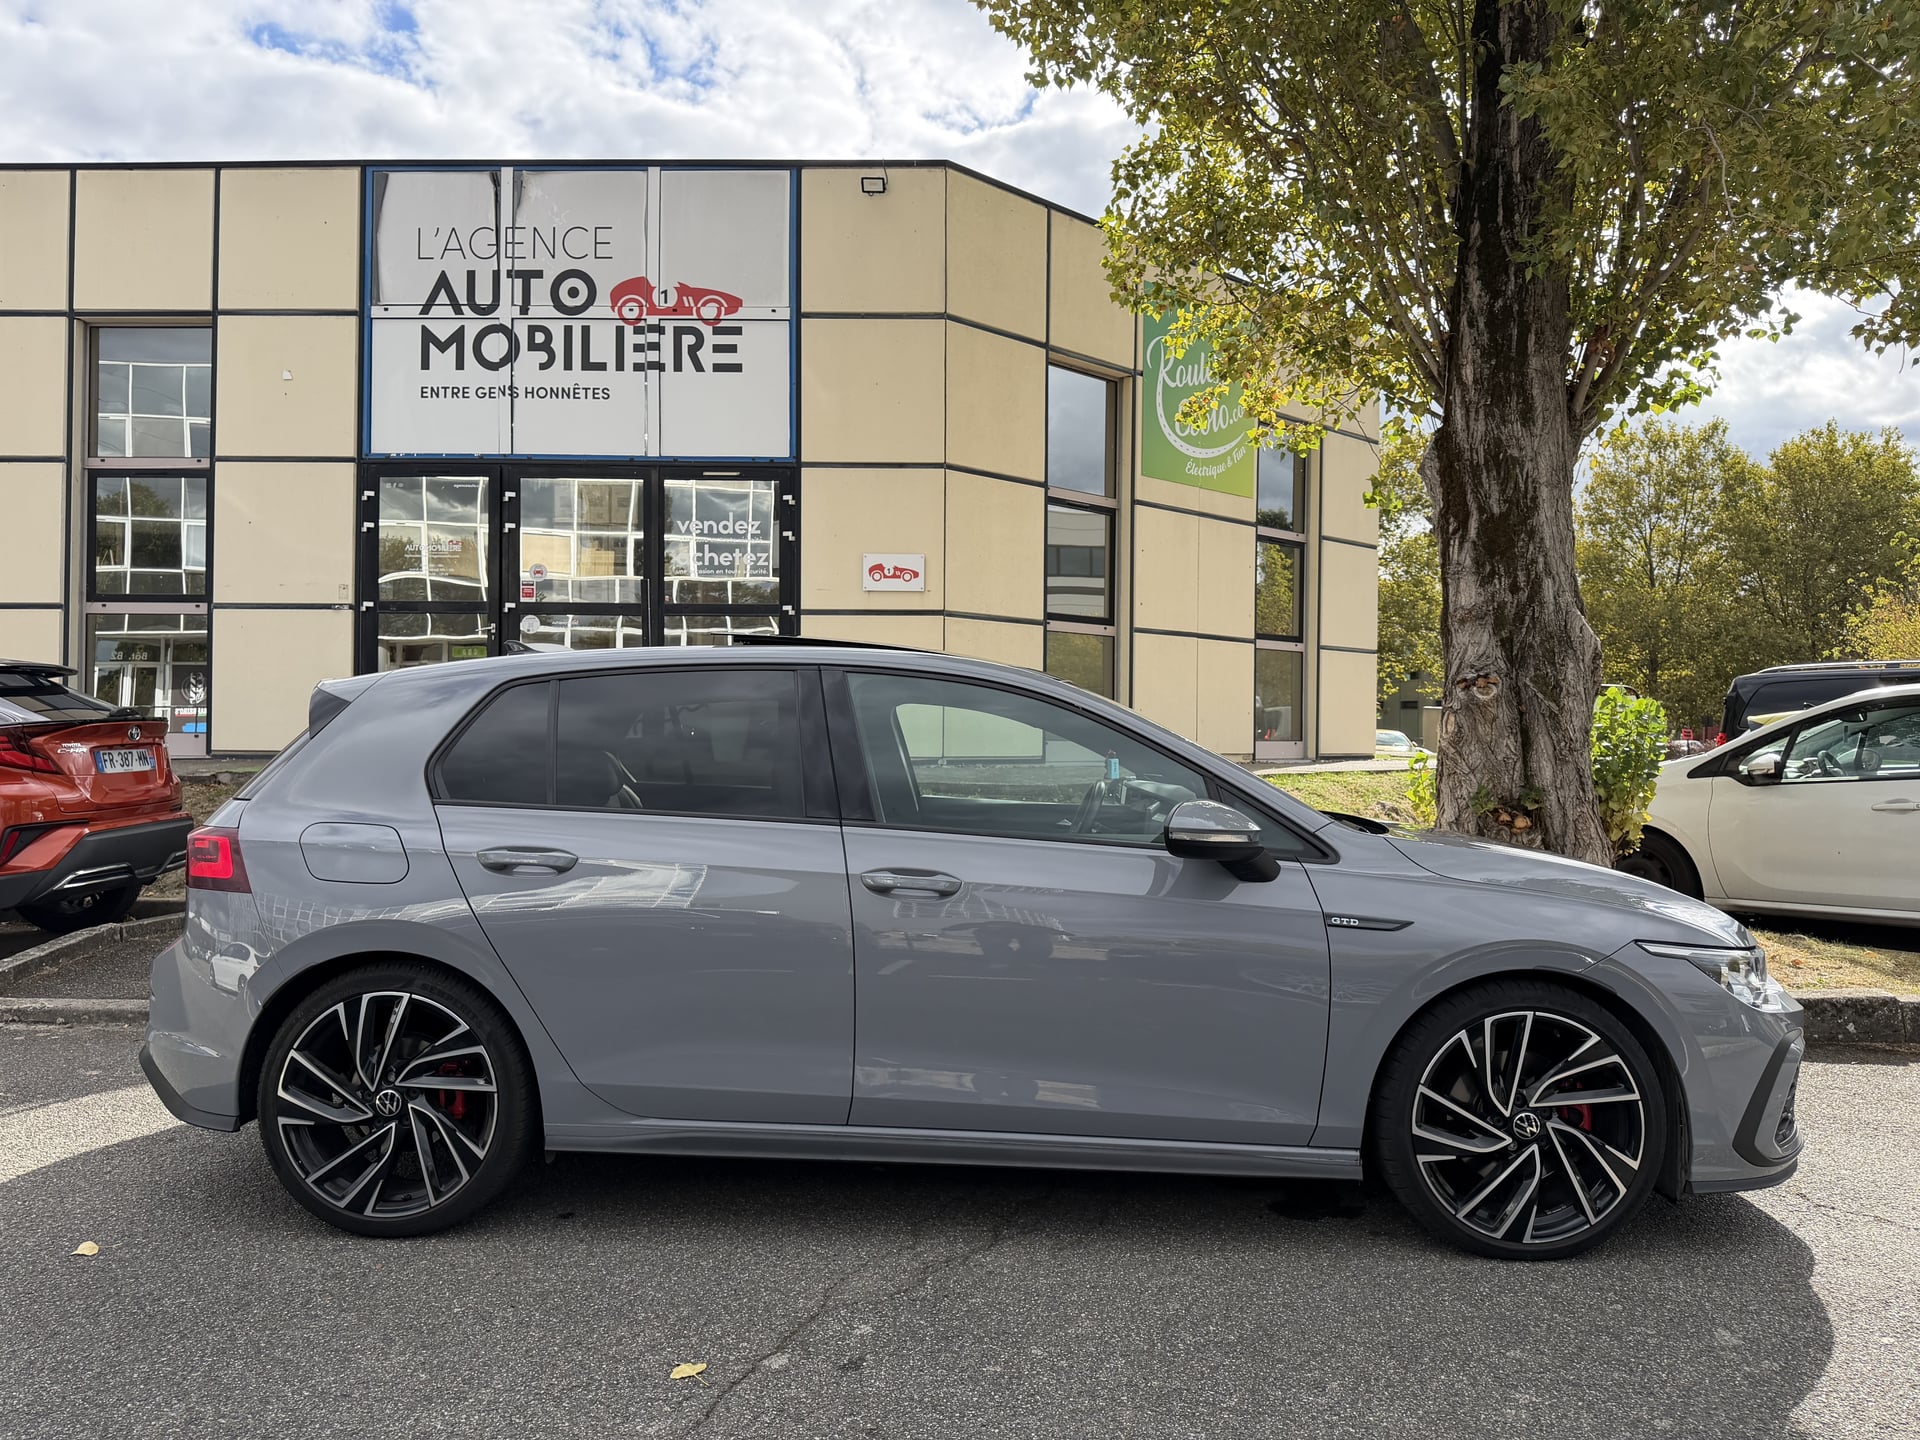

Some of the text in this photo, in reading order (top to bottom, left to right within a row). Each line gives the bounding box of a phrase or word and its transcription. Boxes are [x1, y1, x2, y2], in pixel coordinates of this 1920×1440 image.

[418, 227, 613, 260] L'AGENCE
[419, 269, 597, 316] AUTO
[420, 382, 611, 400] ENTRE GENS HONNÊTES
[1185, 458, 1227, 480] Électrique
[1232, 446, 1246, 463] Fun
[676, 511, 761, 534] vendez
[101, 749, 150, 769] FR-387-MN
[1331, 917, 1359, 926] GTD
